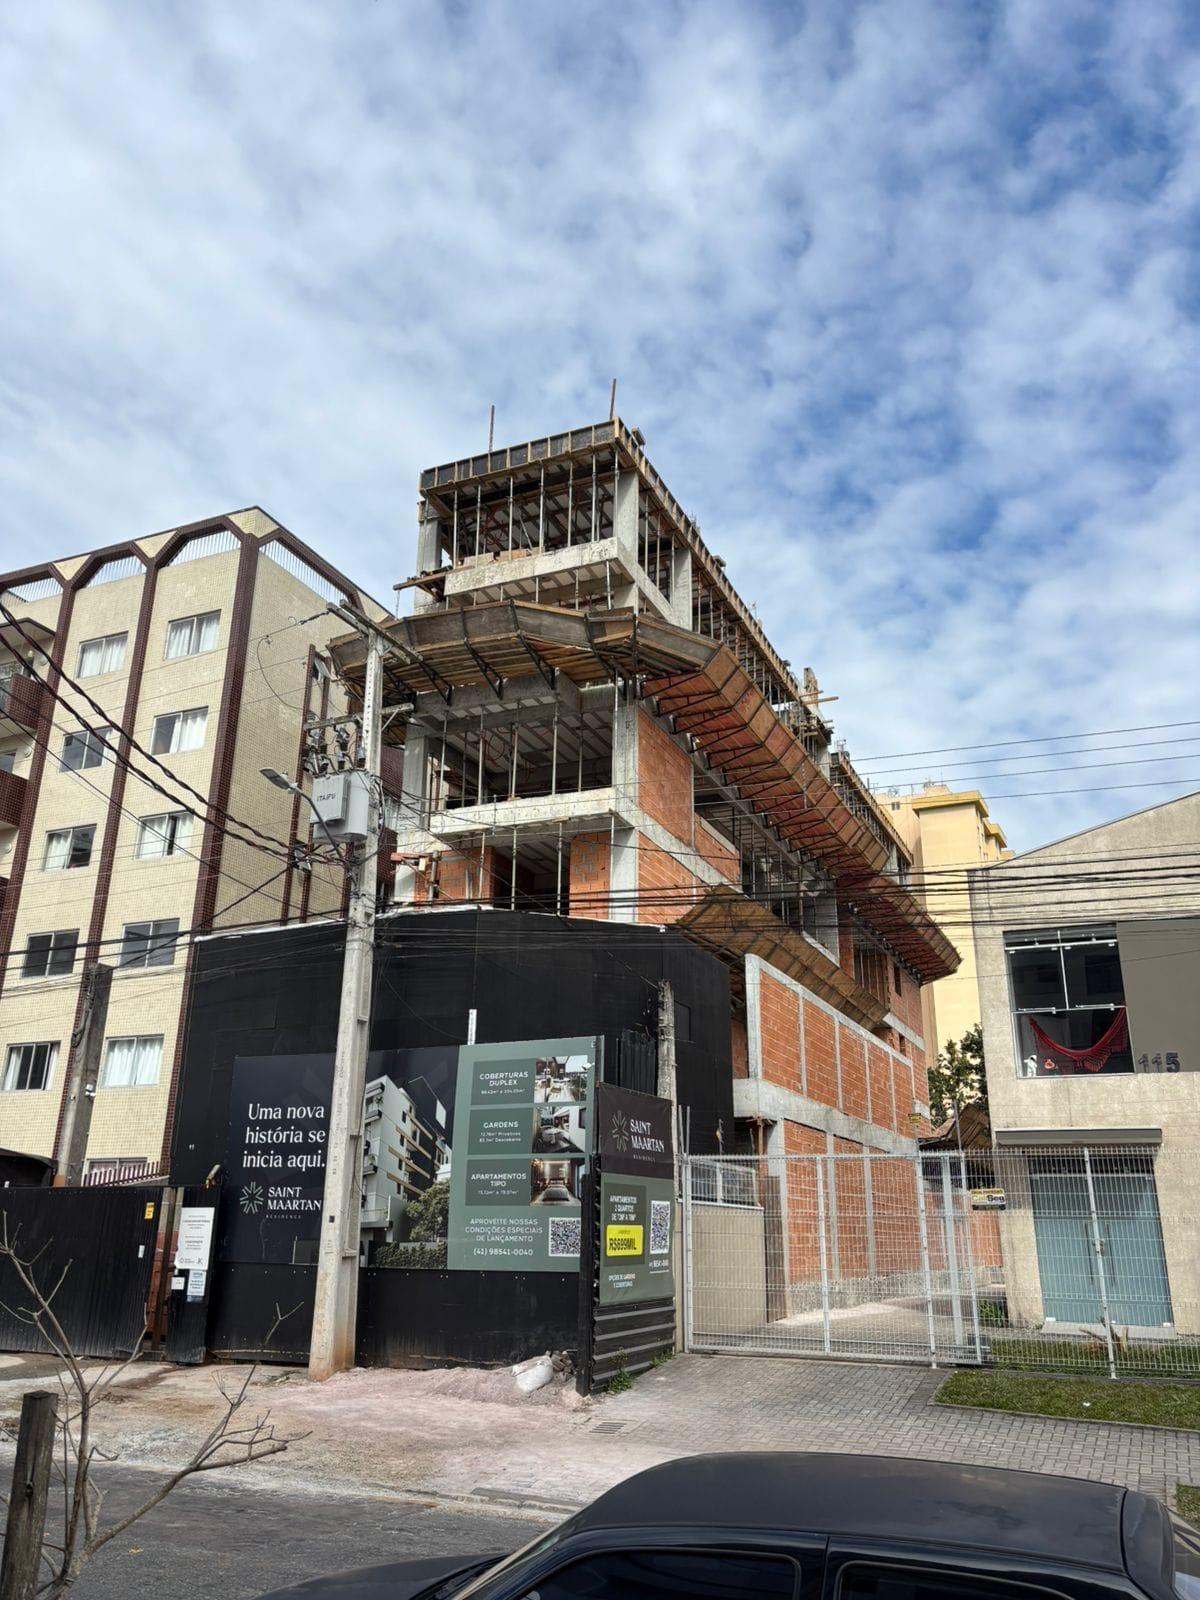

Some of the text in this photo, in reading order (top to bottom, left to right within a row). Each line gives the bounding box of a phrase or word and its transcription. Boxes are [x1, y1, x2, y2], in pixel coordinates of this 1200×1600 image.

[1138, 1052, 1180, 1073] 115
[480, 1071, 529, 1080] COBERTURAS
[489, 1079, 518, 1087] DUPLEX
[248, 1103, 325, 1120] Uma nova
[483, 1121, 519, 1129] GARDENS
[630, 1119, 651, 1135] SAINT
[245, 1126, 326, 1144] história se
[631, 1135, 665, 1153] MAARTAN
[242, 1149, 325, 1172] inicia aqui.
[268, 1186, 302, 1198] SAINT
[267, 1199, 322, 1211] MAARTAN
[465, 1225, 505, 1234] CONDIÇÕES
[487, 1235, 533, 1243] LANÇAMENTO
[473, 1248, 534, 1256] (41) 98541-0040
